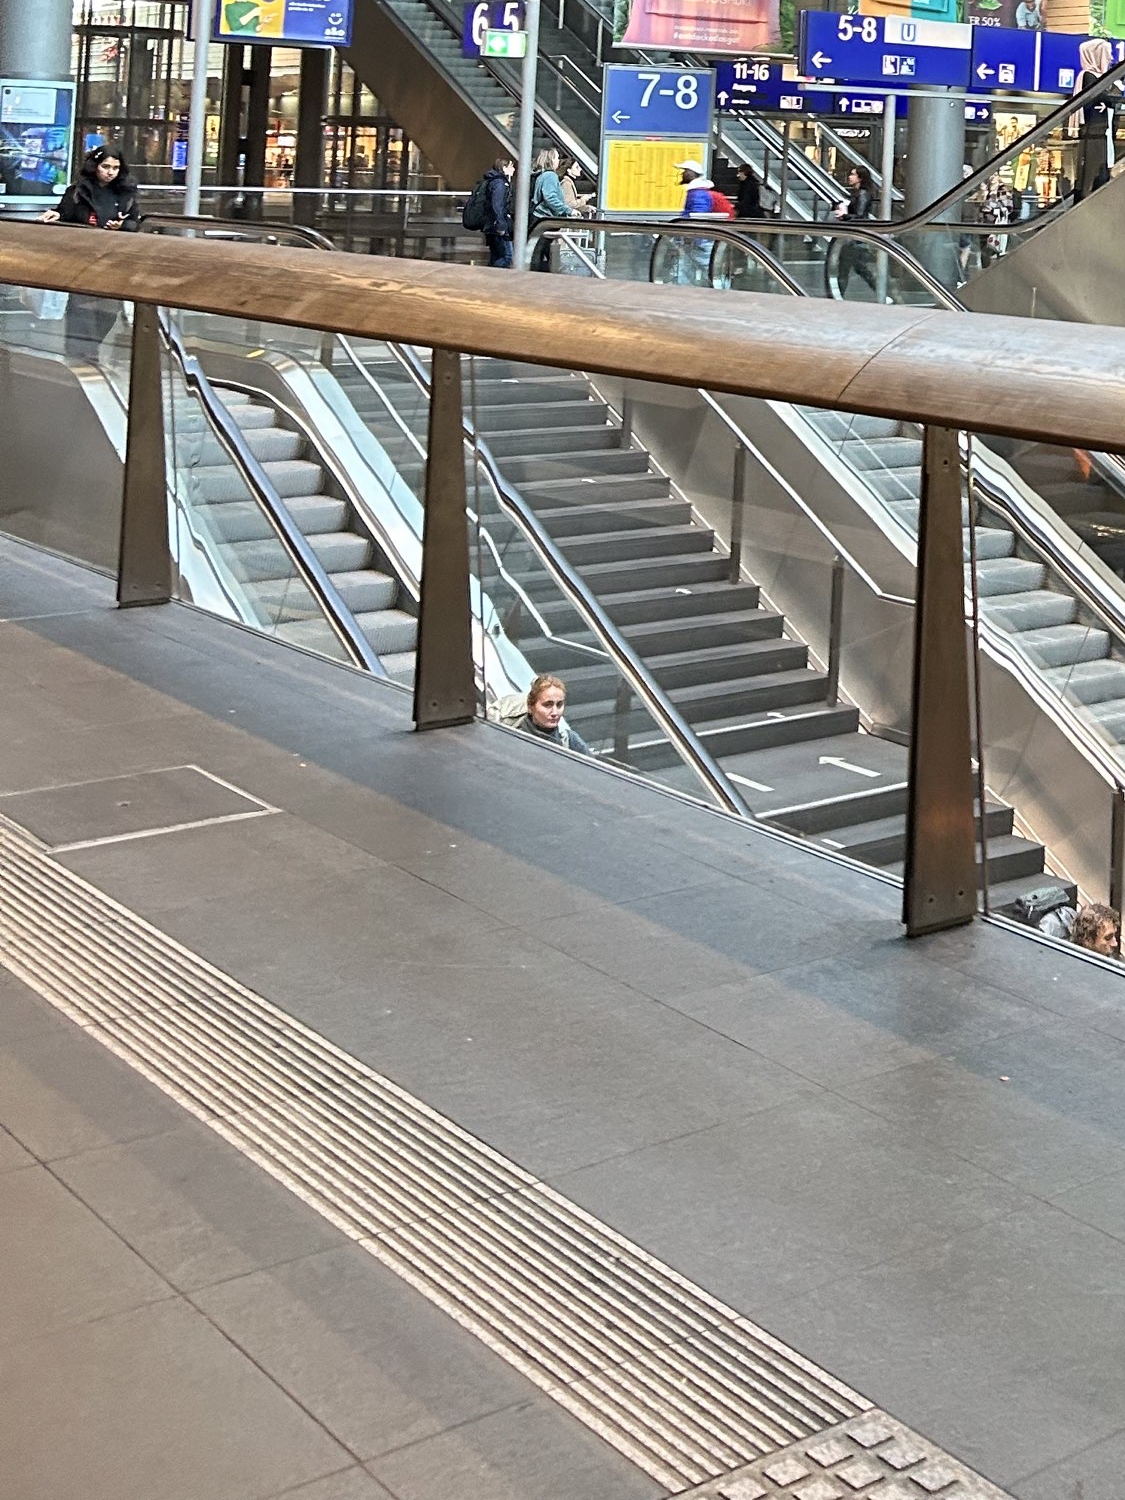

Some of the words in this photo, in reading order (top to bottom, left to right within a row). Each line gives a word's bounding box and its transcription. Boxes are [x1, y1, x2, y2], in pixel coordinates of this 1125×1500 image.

[472, 2, 489, 47] 6
[503, 2, 519, 32] 5
[838, 15, 877, 42] 5-8
[981, 16, 1002, 27] 50%
[733, 62, 770, 81] 11-16
[637, 73, 698, 110] 7-8
